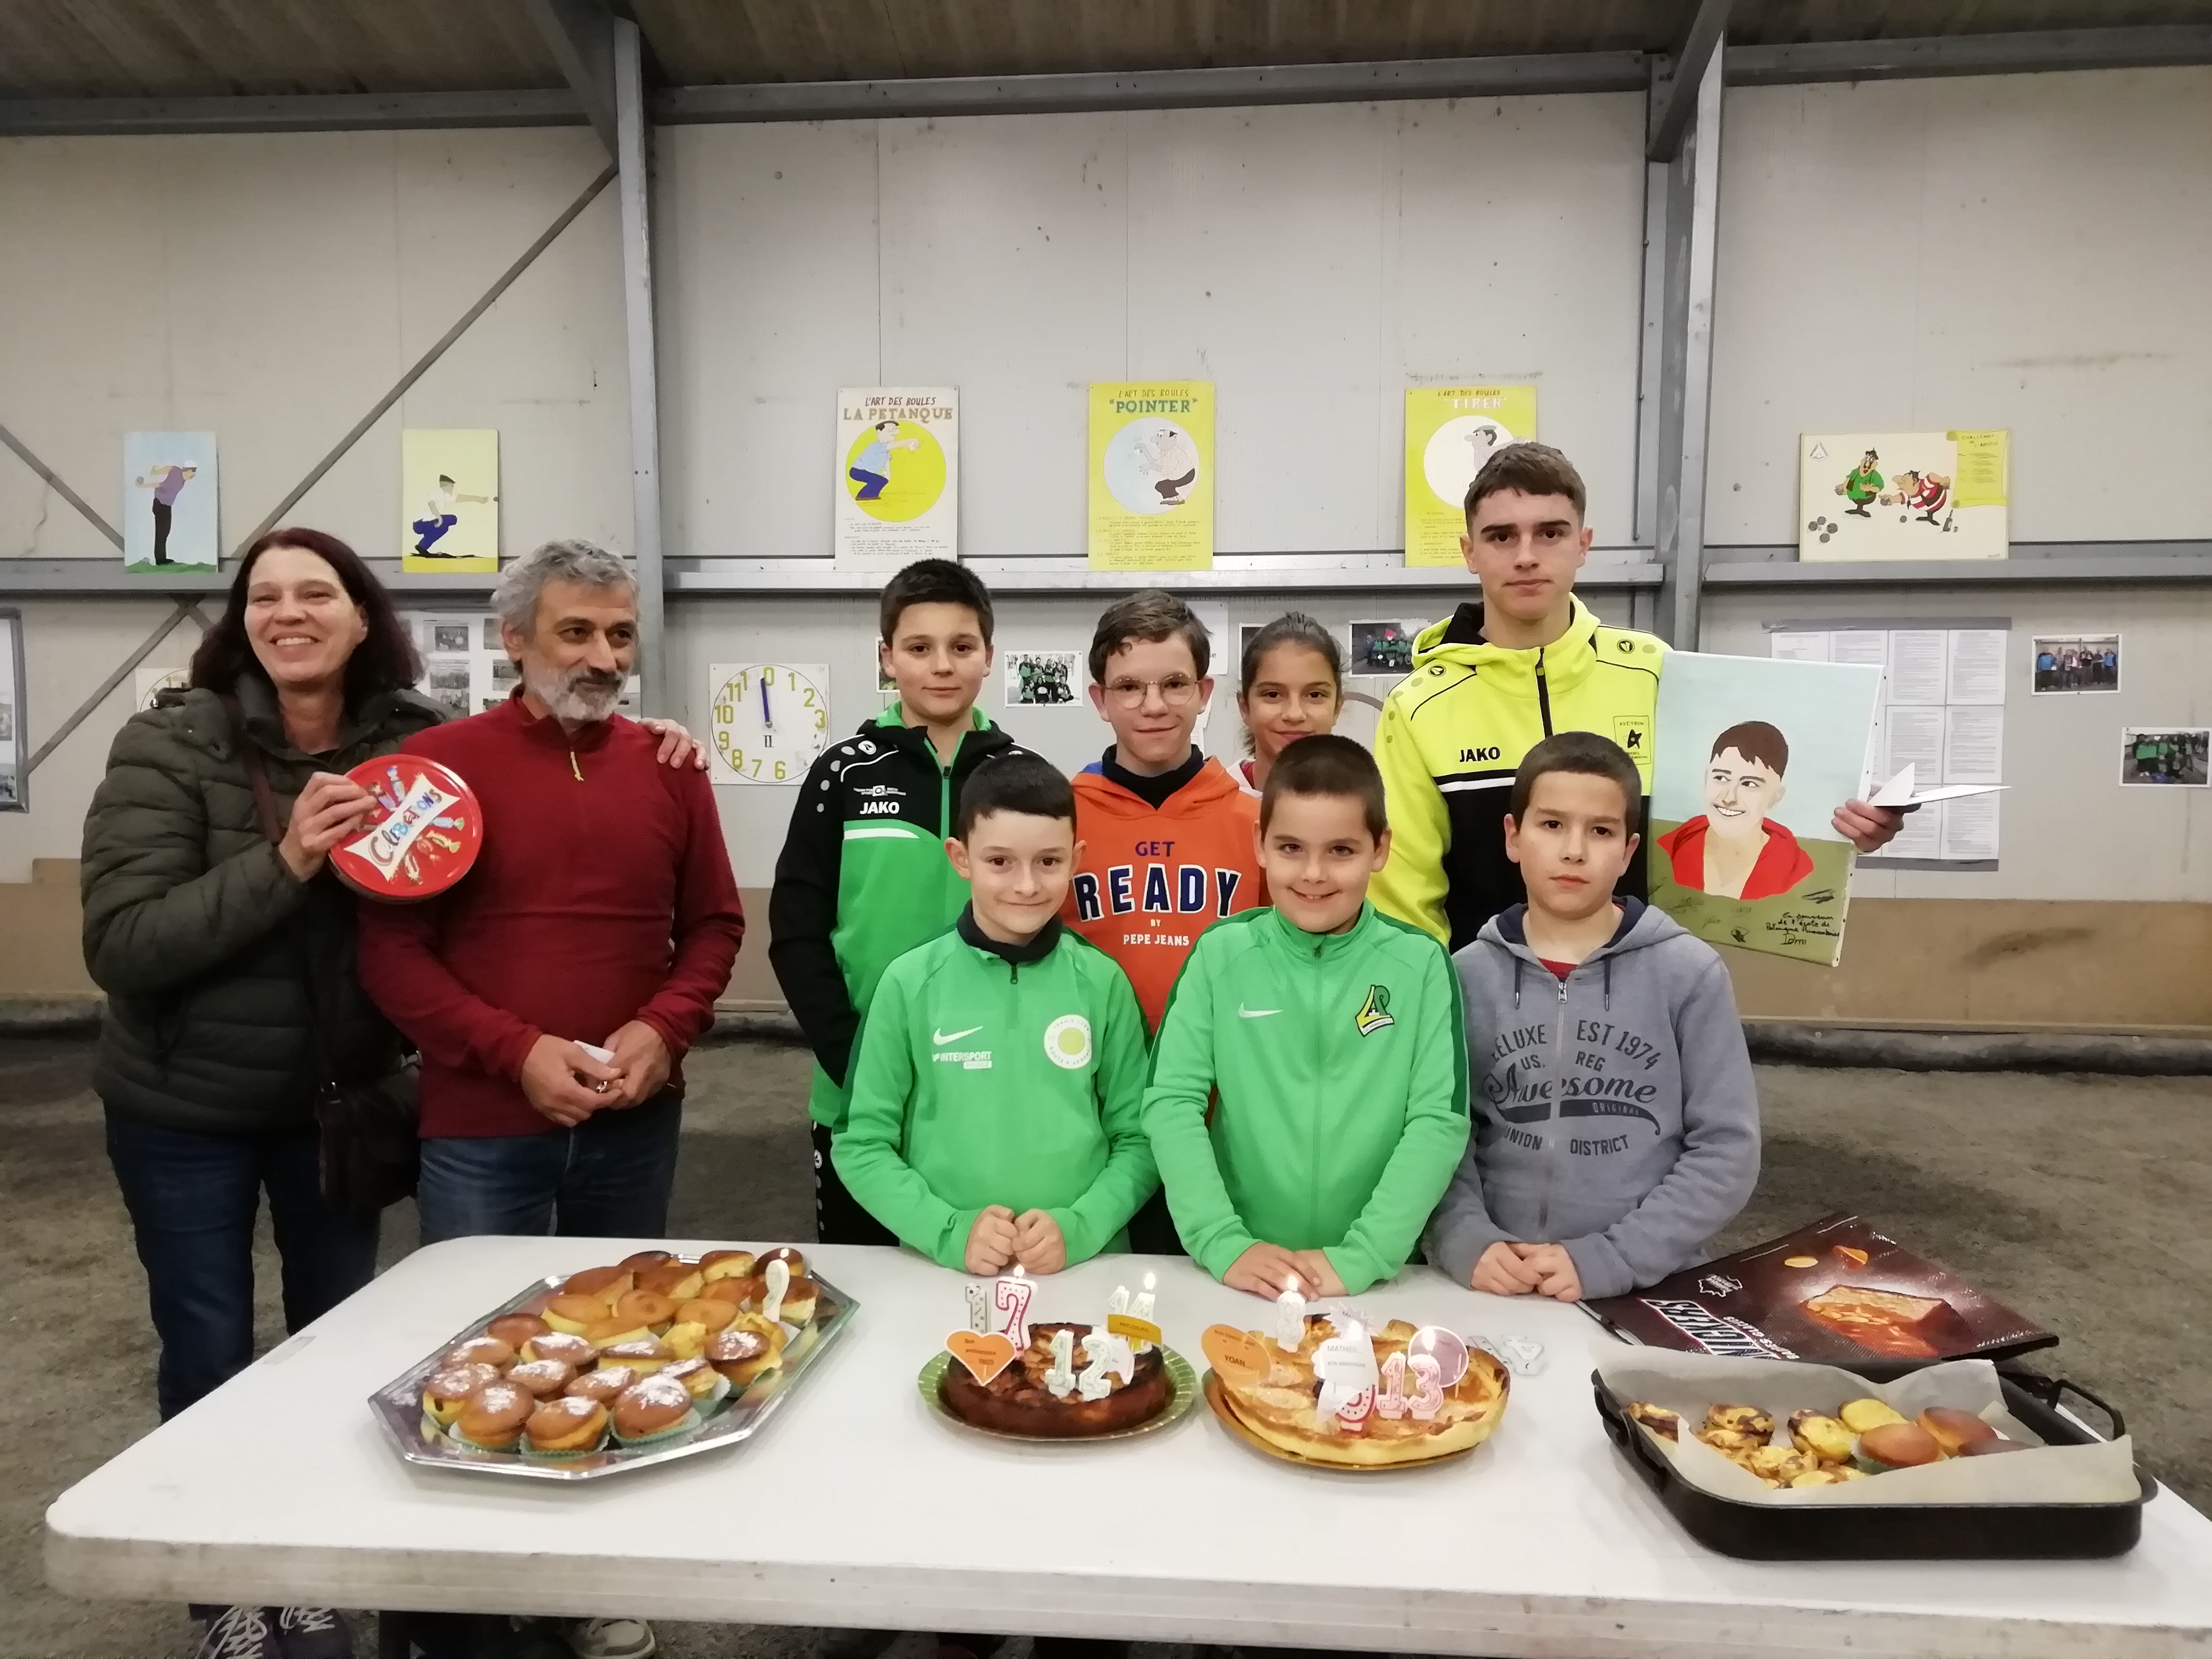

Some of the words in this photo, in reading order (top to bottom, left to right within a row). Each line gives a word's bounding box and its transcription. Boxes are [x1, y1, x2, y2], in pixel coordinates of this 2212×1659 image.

[865, 397, 886, 407] L'ART
[889, 397, 903, 406] DES
[906, 397, 936, 406] BOULES
[1160, 389, 1189, 397] BOULES
[843, 408, 864, 421] LA
[868, 407, 953, 424] PETANQUE
[764, 667, 775, 686] 0
[788, 672, 795, 691] 1
[726, 683, 741, 702] 11
[803, 688, 815, 707] 2
[715, 705, 734, 724] 10
[815, 709, 826, 728] 3
[719, 731, 729, 750] 9
[732, 749, 743, 769] 8
[1459, 746, 1501, 763] JAKO
[751, 759, 762, 777] 7
[775, 761, 786, 780] 6
[859, 801, 900, 814] JAKO
[1135, 841, 1175, 857] GET
[1072, 862, 1242, 923] READY
[1123, 934, 1151, 945] PEPE
[1154, 934, 1189, 946] JEANS
[1577, 1019, 1615, 1045] EST
[1615, 1030, 1662, 1070] 1974
[940, 1051, 992, 1062] INTERSPORT
[1575, 1050, 1605, 1072] REG
[1482, 1062, 1657, 1105] Awesome
[1570, 1134, 1629, 1155] DISTRICT
[1644, 1299, 1778, 1359] NICKERS
